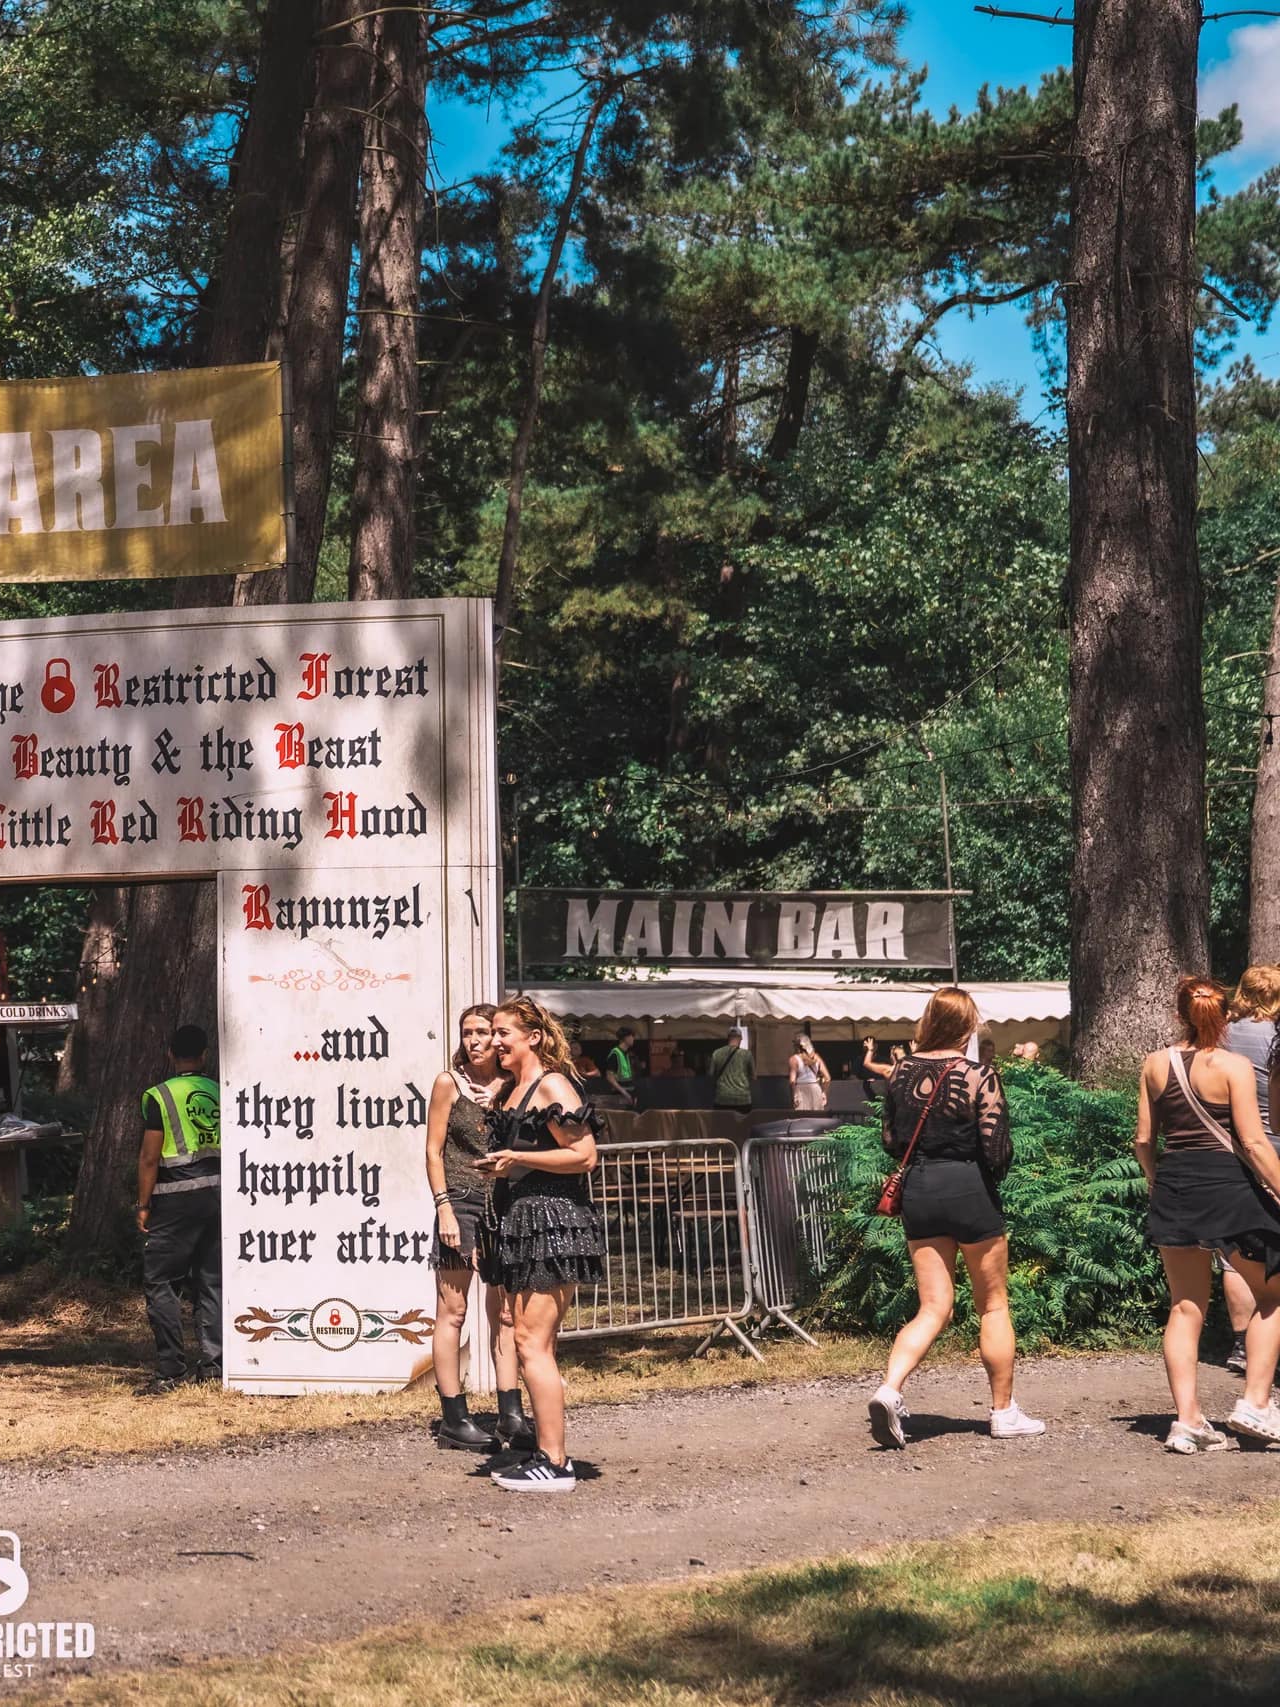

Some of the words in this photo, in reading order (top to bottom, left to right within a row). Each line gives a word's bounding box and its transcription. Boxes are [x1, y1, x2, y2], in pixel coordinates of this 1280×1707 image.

[94, 658, 277, 710] Restricted
[297, 652, 430, 700] Forest
[12, 733, 132, 786] Beauty
[151, 728, 181, 775] &
[199, 727, 254, 781] the
[274, 722, 382, 770] Beast
[89, 799, 158, 846] Red
[177, 793, 303, 850] Riding
[323, 792, 427, 840] Hood
[242, 883, 424, 940] Rapunzel
[563, 899, 751, 959] MAIN
[771, 901, 908, 960] BAR
[0, 1006, 26, 1018] COLD
[29, 1005, 67, 1018] DRINKS
[236, 1082, 316, 1140] they
[336, 1083, 426, 1129] lived
[237, 1149, 381, 1207] happily
[238, 1224, 316, 1264] ever
[316, 1326, 355, 1335] RESTRICTED
